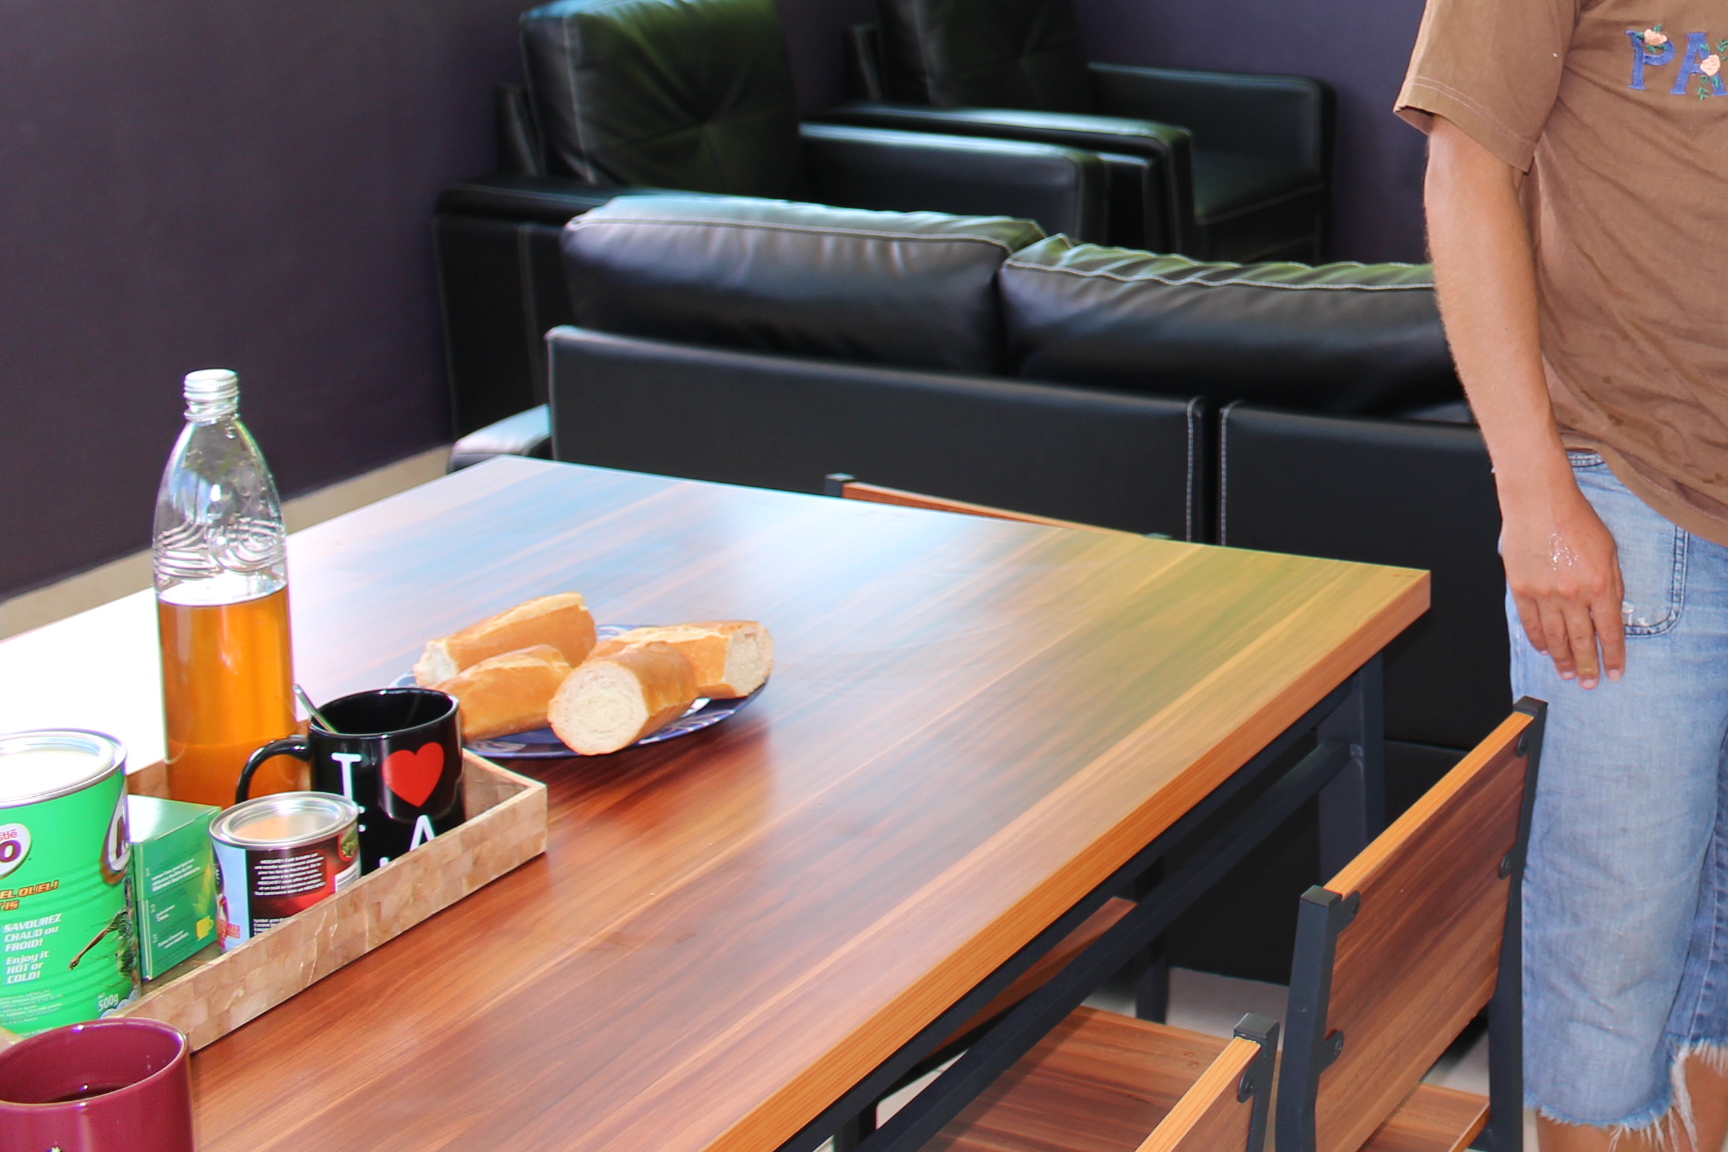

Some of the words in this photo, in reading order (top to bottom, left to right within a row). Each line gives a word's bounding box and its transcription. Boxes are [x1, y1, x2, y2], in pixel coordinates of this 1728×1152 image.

[4, 913, 62, 933] SAVOUREZ
[4, 929, 43, 943] CHAUD
[5, 938, 44, 952] FROID!
[6, 953, 38, 965] Enjoy
[40, 950, 50, 959] it
[6, 963, 30, 974] HOT
[31, 962, 44, 970] or
[7, 970, 41, 984] COLD!
[98, 993, 119, 1012] 500g
